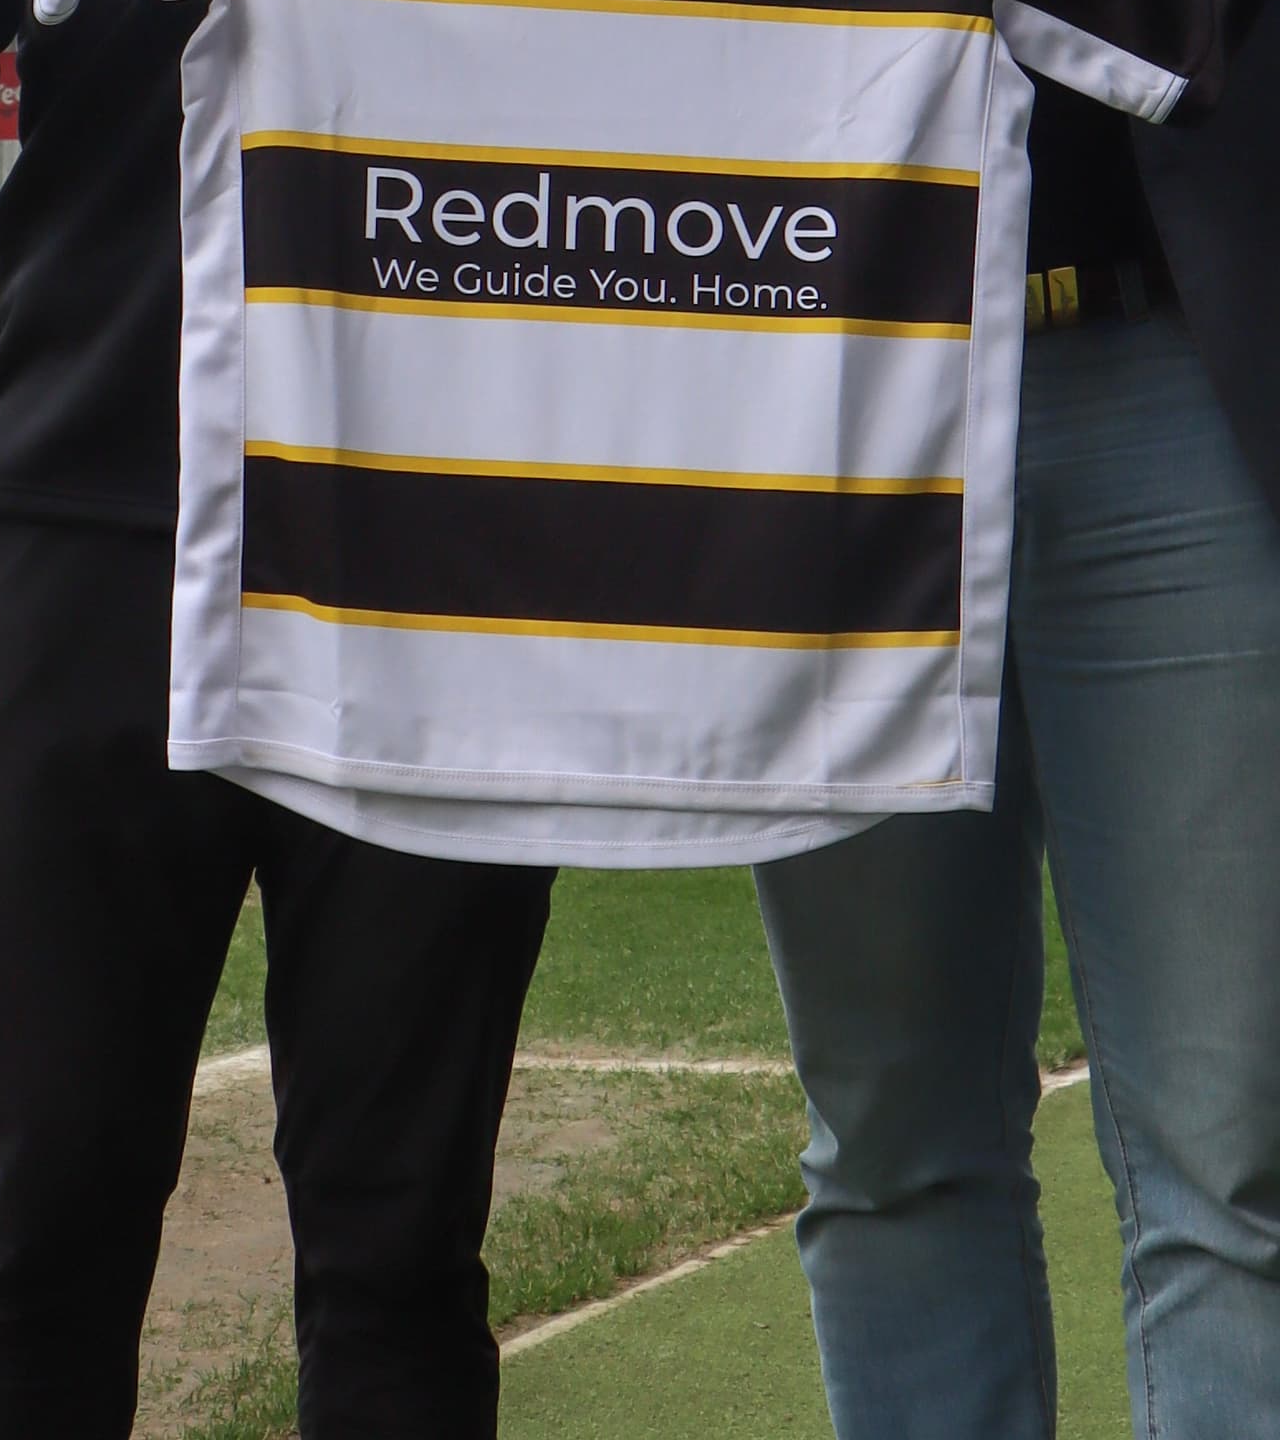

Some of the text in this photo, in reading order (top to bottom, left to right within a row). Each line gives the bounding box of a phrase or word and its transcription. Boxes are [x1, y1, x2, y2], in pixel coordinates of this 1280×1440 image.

[365, 166, 838, 262] Redmove
[372, 257, 827, 310] We Guide You. Home.
